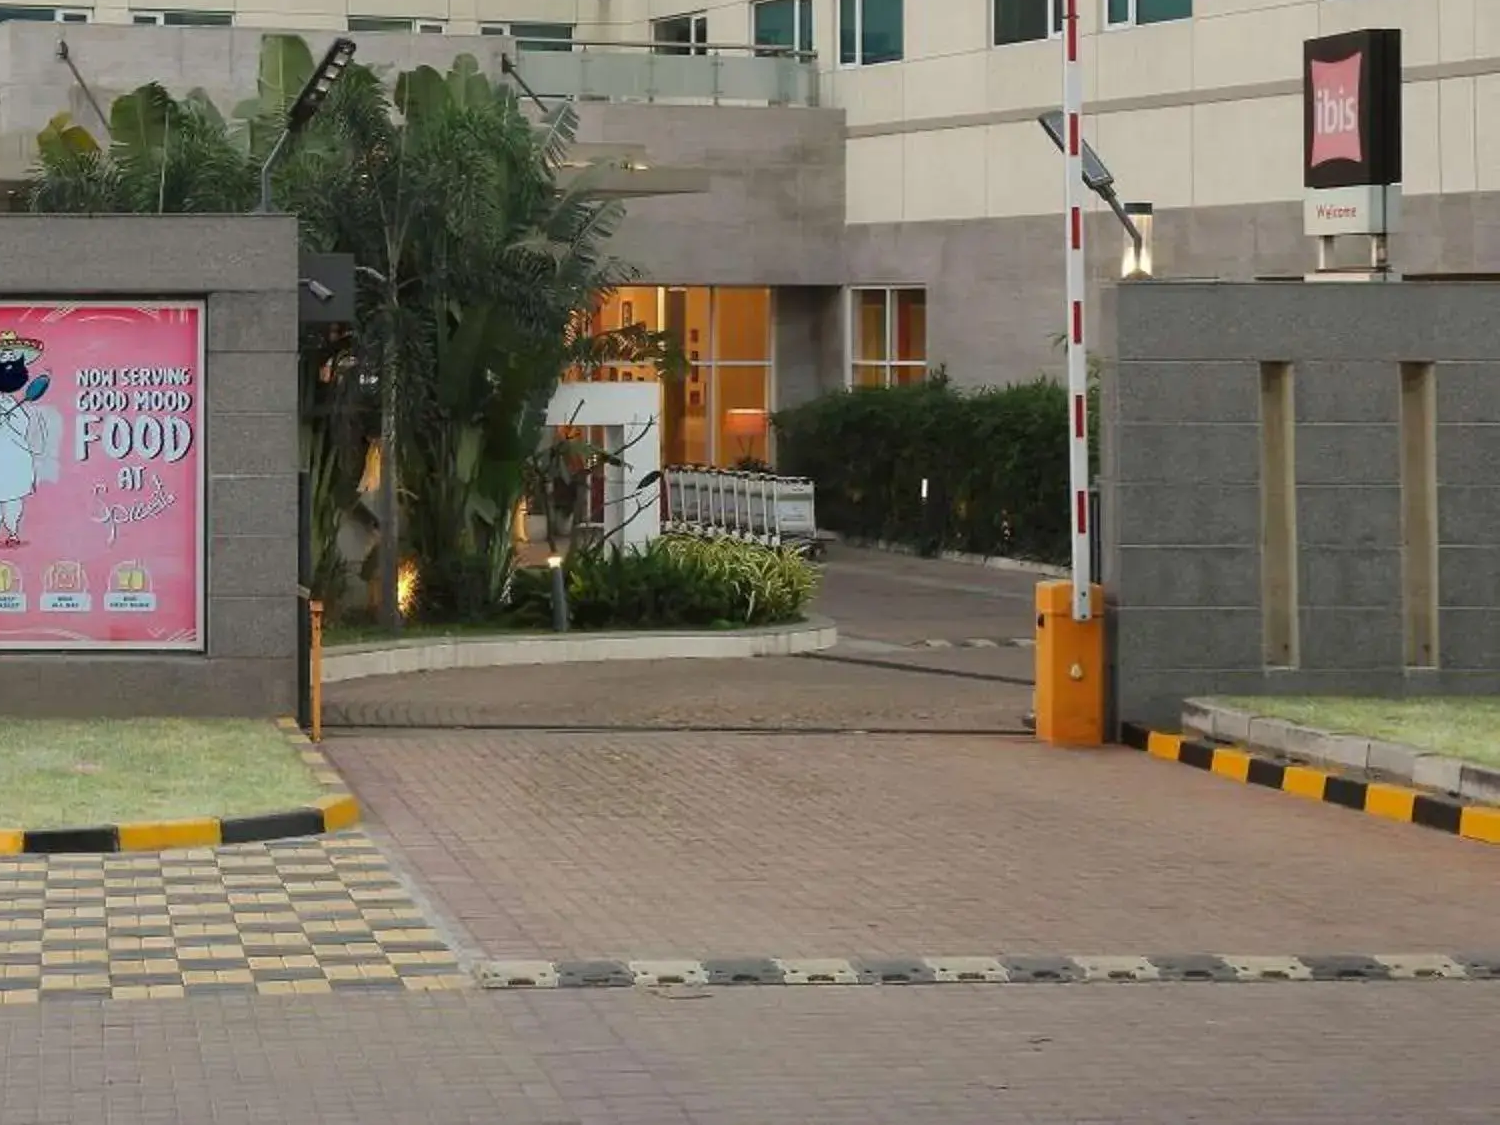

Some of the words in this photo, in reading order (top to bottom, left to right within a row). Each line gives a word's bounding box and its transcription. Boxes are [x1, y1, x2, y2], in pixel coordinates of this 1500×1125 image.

[1315, 86, 1357, 135] ibis
[76, 368, 117, 388] NOW
[121, 367, 193, 387] SERVING
[77, 390, 130, 412] GOOD
[134, 389, 194, 413] MOOD
[75, 413, 194, 464] FOOD
[117, 465, 147, 491] AT
